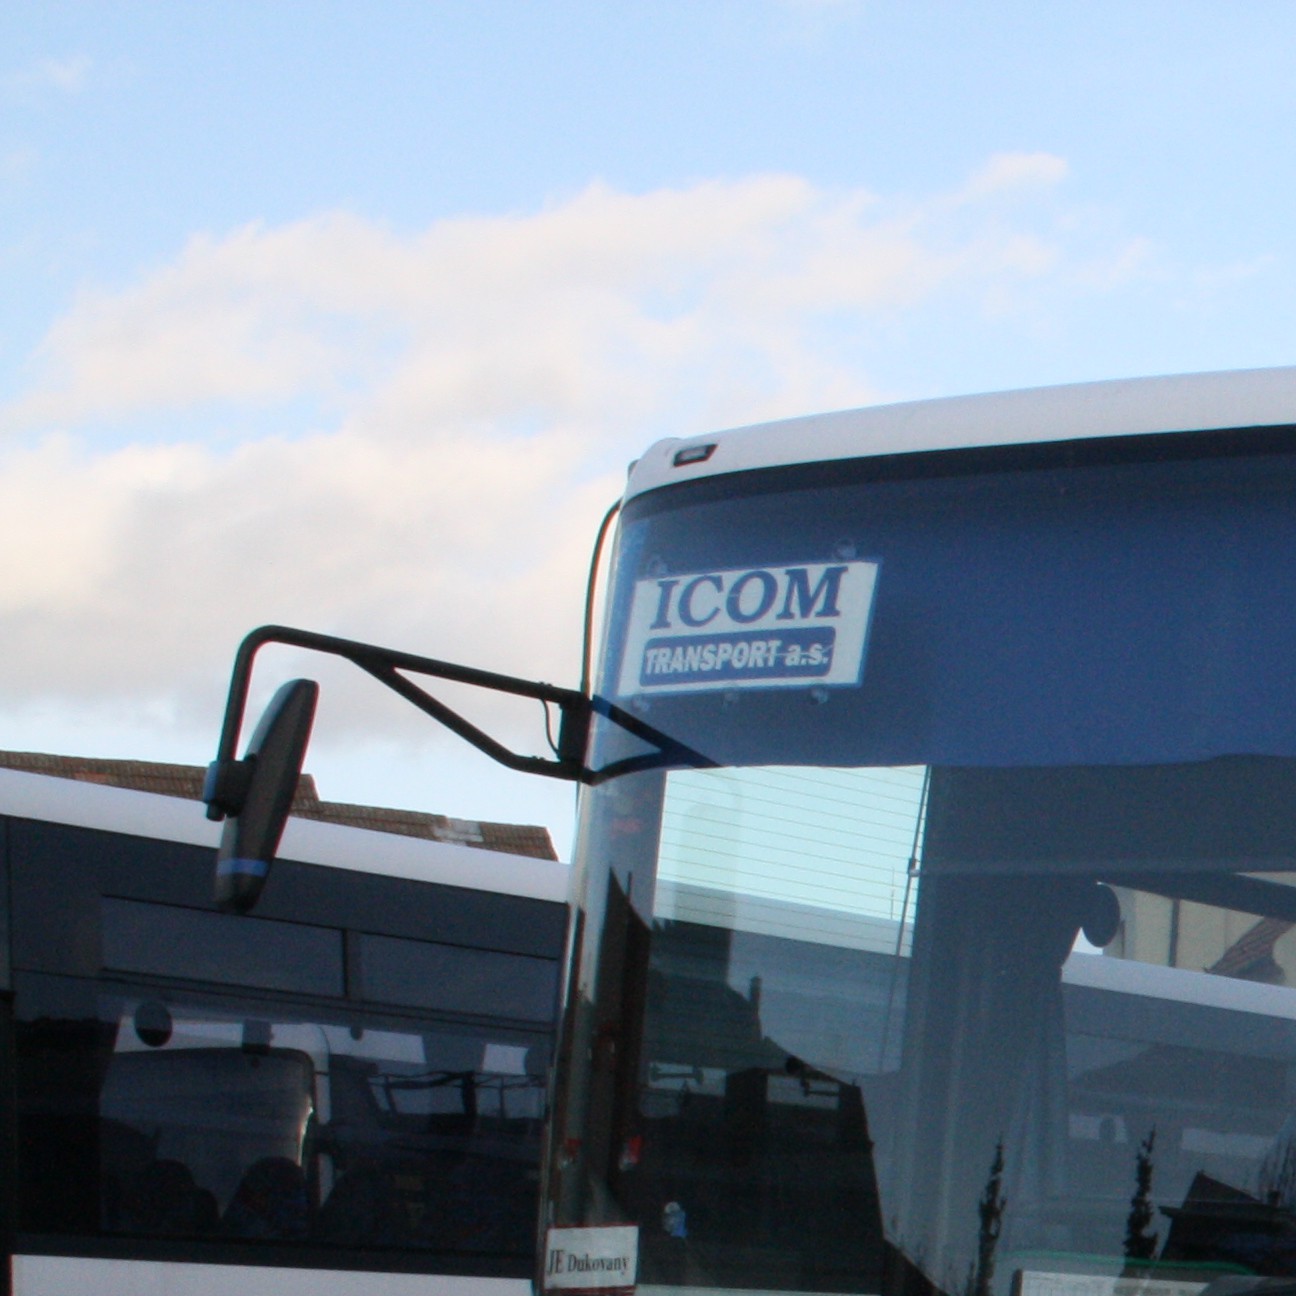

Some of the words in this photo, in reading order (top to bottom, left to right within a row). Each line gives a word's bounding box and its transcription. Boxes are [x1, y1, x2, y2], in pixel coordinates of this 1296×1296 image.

[649, 566, 848, 630] ICOM
[645, 640, 781, 674] TRANSPORT
[786, 643, 829, 667] a.s.
[567, 1253, 629, 1276] Dukovany
